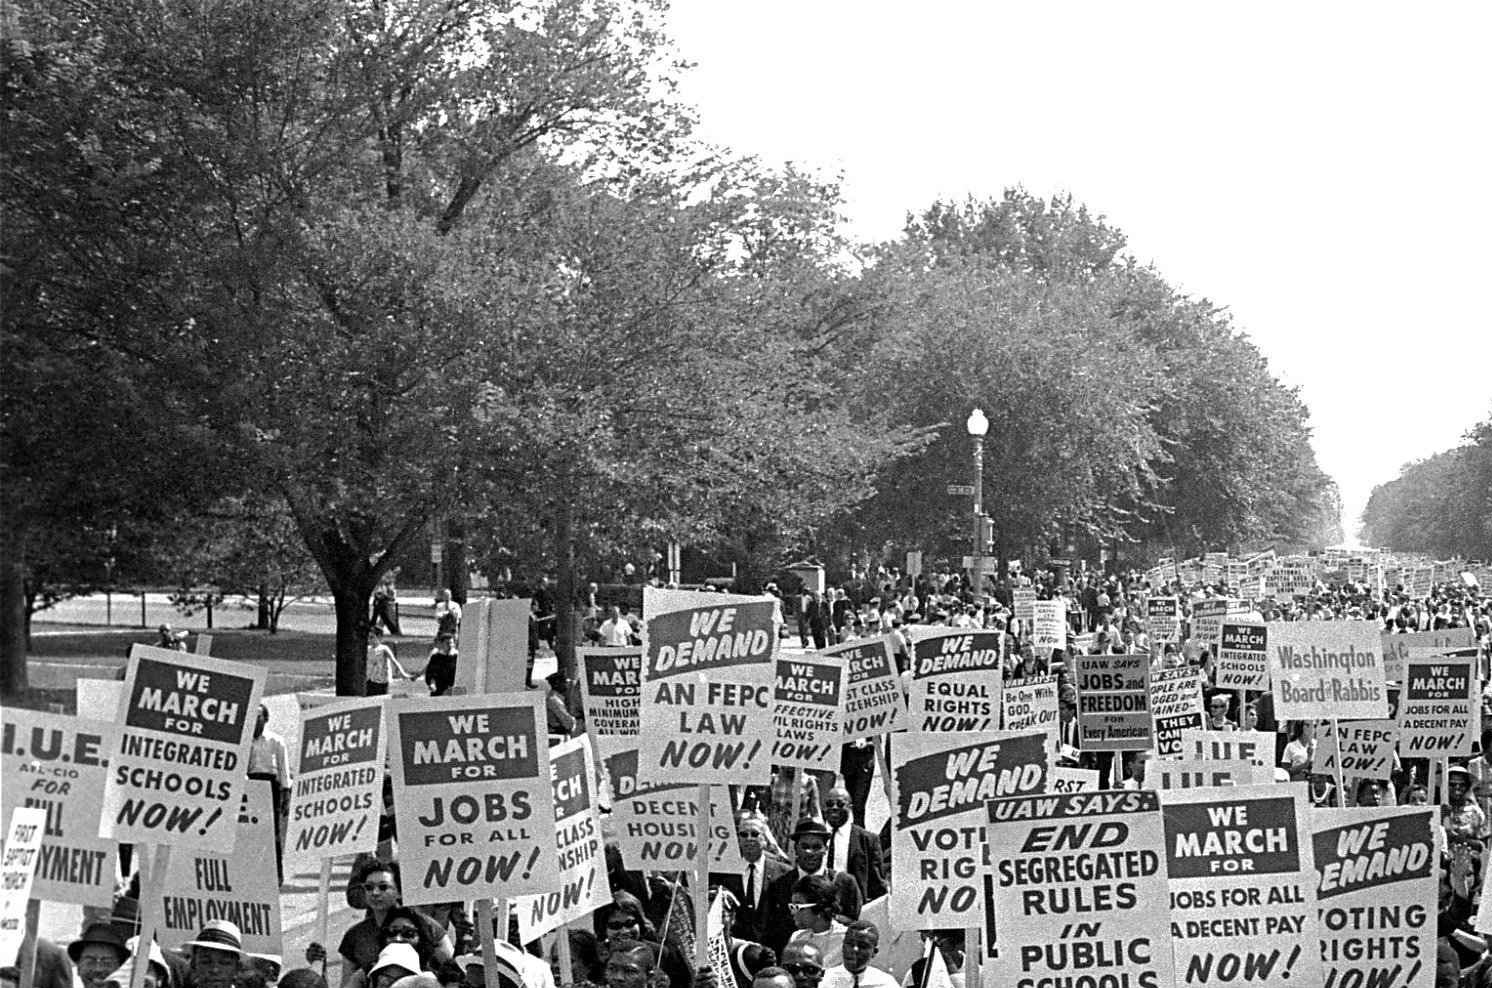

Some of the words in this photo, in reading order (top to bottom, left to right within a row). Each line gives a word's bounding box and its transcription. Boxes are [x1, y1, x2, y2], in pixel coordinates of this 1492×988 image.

[690, 608, 737, 638] WE
[655, 629, 769, 672] DEMAND
[941, 635, 975, 655] WE
[1224, 633, 1265, 646] MARCH
[919, 648, 997, 675] DEMAND
[1080, 660, 1111, 671] UAW
[1219, 651, 1268, 662] INTEGRATED
[1219, 661, 1267, 674] SCHOOLS
[1276, 644, 1377, 675] Washington
[790, 663, 815, 678] WE
[1079, 672, 1125, 691] JOBS
[1221, 673, 1267, 687] NOW!
[1430, 665, 1450, 677] WE
[177, 671, 211, 694] WE
[860, 679, 896, 697] CLASS
[926, 681, 990, 698] EQUAL
[1280, 678, 1326, 703] Board
[1331, 677, 1382, 703] Rabbis
[1411, 677, 1466, 690] MARCH
[138, 687, 239, 725] MARCH
[654, 682, 696, 706] AN
[707, 682, 770, 708] FEPC
[786, 691, 814, 703] FOR
[1079, 694, 1148, 713] FREEDOM
[1427, 691, 1450, 699] FOR
[924, 698, 991, 716] RIGHTS
[1038, 709, 1059, 724] OUT
[1405, 704, 1430, 715] JOBS
[1431, 703, 1451, 715] FOR
[1452, 703, 1470, 714] ALL
[165, 717, 205, 735] FOR
[327, 714, 352, 733] WE
[448, 713, 490, 735] WE
[680, 710, 748, 736] LAW
[1104, 716, 1125, 724] FOR
[1159, 715, 1195, 729] THEY
[1412, 719, 1449, 730] DECENT
[1449, 718, 1469, 729] PAY
[305, 727, 374, 758] MARCH
[776, 727, 815, 742] LAWS
[1083, 725, 1107, 741] Every
[1353, 729, 1395, 744] FEPC
[1409, 732, 1466, 751] NOW!
[120, 733, 239, 772] INTEGRATED
[323, 752, 350, 766] FOR
[413, 734, 529, 765] MARCH
[659, 739, 762, 770] NOW!
[1339, 742, 1379, 756] LAW
[451, 764, 498, 779] FOR
[945, 743, 1002, 781] WE
[31, 779, 71, 797] FOR
[116, 765, 232, 801] SCHOOLS
[296, 767, 376, 797] INTEGRATED
[906, 762, 1043, 820] DEMAND
[116, 798, 223, 836] NOW!
[294, 792, 373, 821] SCHOOLS
[418, 790, 532, 827] JOBS
[994, 797, 1059, 821] UAW
[1206, 805, 1249, 827] WE
[295, 814, 368, 852] NOW!
[424, 831, 475, 847] FOR
[488, 827, 531, 843] ALL
[1019, 821, 1130, 854] END
[1174, 827, 1289, 858] MARCH
[1336, 821, 1390, 859] WE
[194, 858, 233, 893] FULL
[422, 845, 541, 889] NOW!
[999, 849, 1160, 887] SEGREGATED
[1209, 858, 1256, 873] FOR
[1022, 882, 1139, 916] RULES
[1168, 890, 1217, 910] JOBS
[1221, 887, 1263, 908] FOR
[1266, 884, 1306, 905] ALL
[1059, 922, 1103, 939] IN
[1185, 917, 1261, 939] DECENT
[1264, 914, 1307, 935] PAY
[1020, 937, 1153, 972] PUBLIC
[1184, 943, 1302, 984] NOW!
